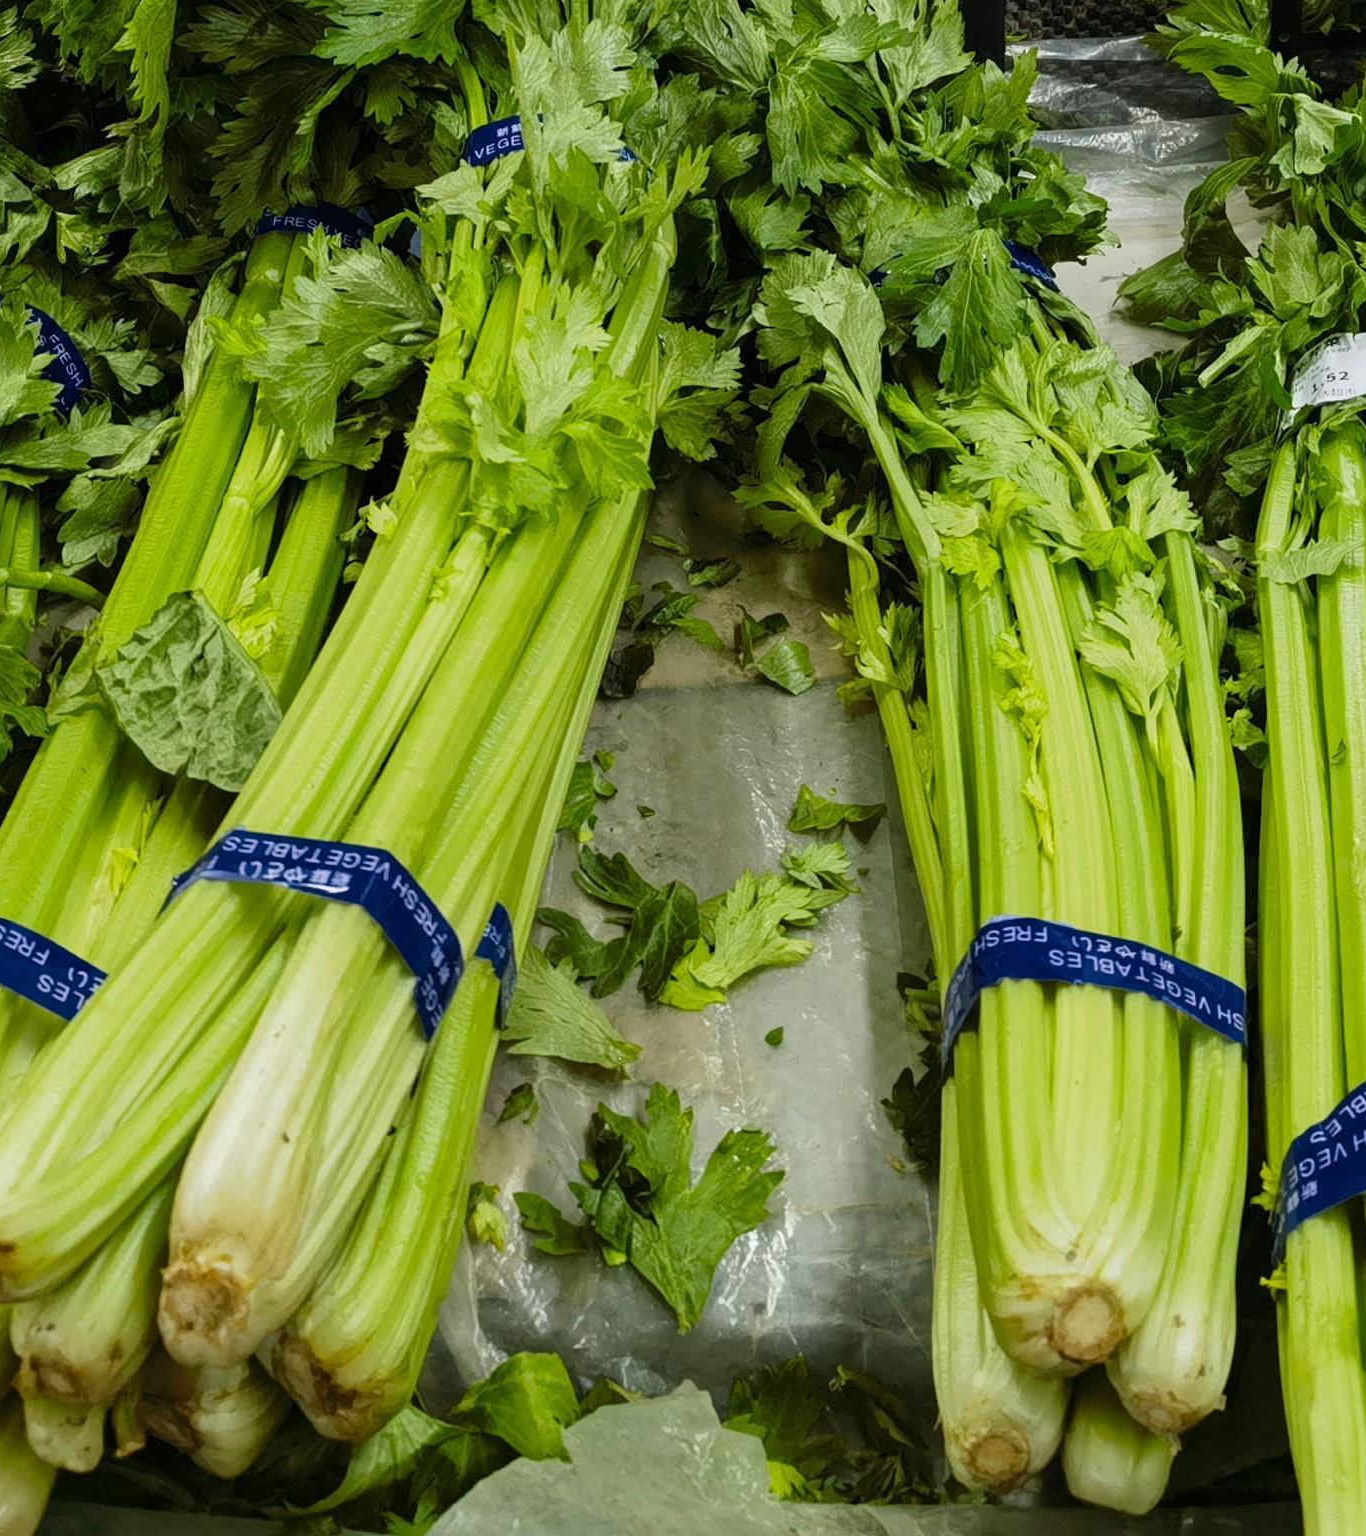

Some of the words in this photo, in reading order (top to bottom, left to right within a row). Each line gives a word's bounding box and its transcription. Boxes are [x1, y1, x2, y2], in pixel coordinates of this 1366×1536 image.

[47, 333, 84, 388] FRESH
[221, 835, 392, 882] VEGETABLES
[974, 925, 1049, 958] FRESH
[1047, 948, 1212, 1016] VEGETABLES
